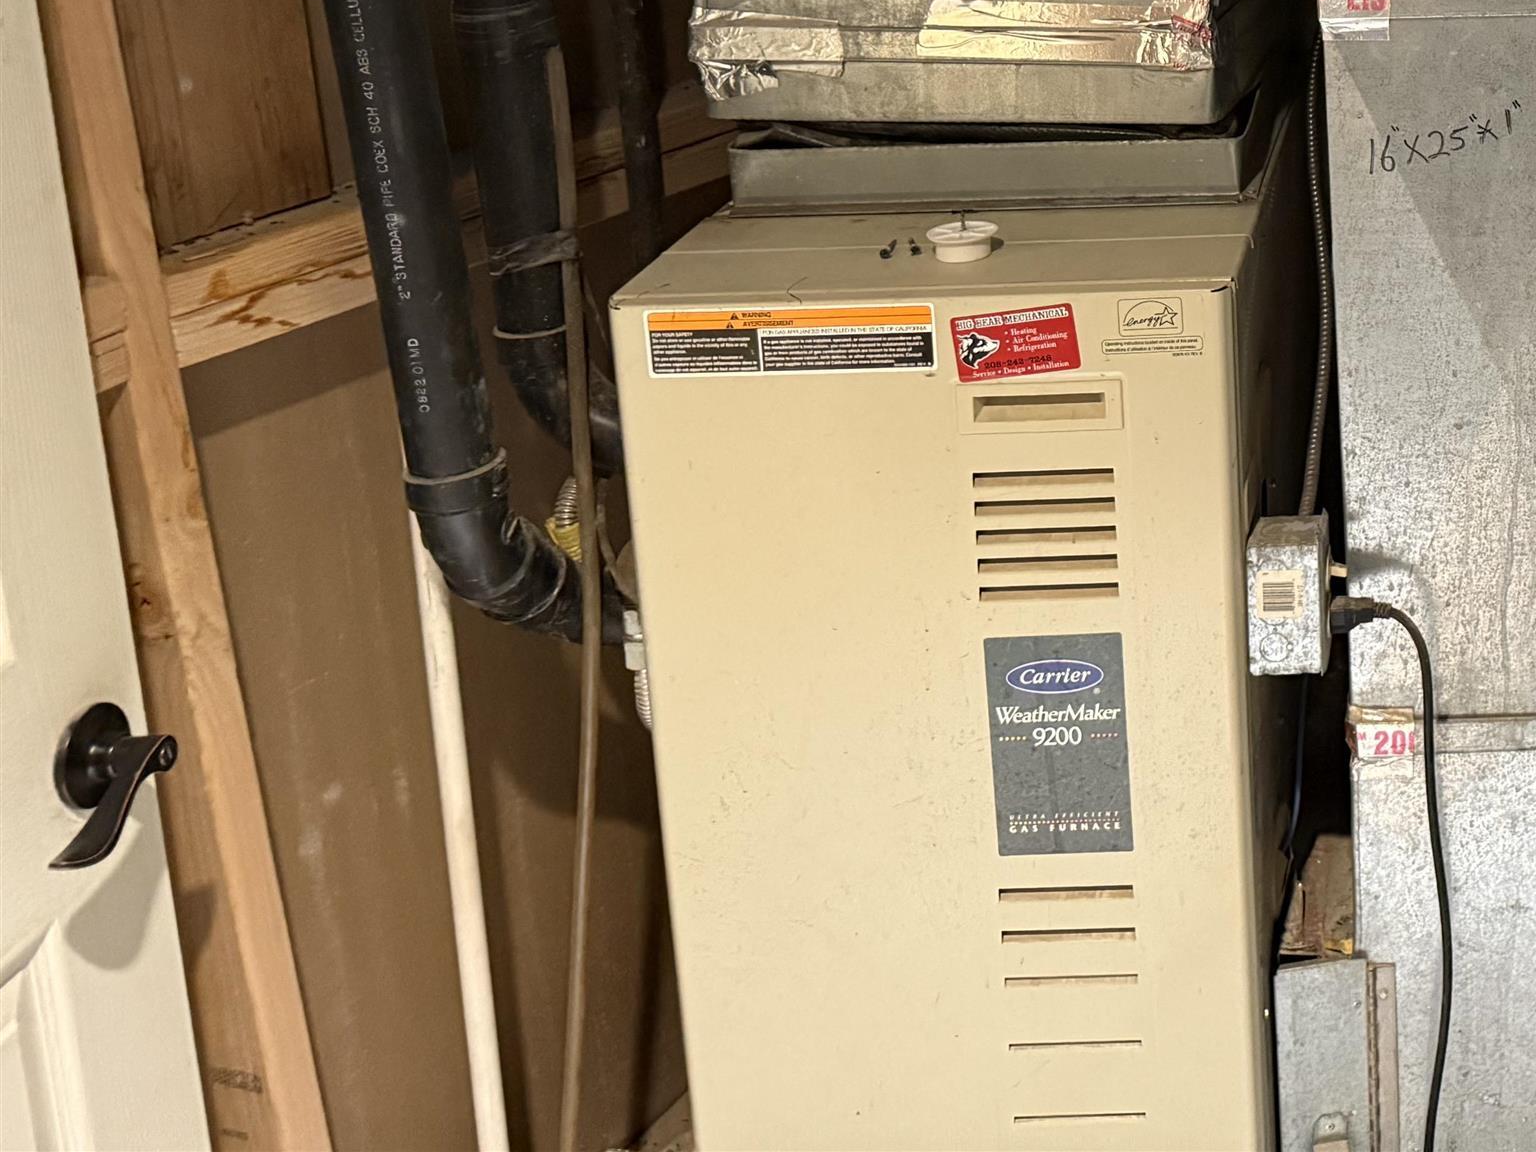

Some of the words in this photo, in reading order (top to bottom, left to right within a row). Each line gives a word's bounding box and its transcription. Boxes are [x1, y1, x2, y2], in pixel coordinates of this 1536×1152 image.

[363, 81, 375, 101] 40
[366, 106, 382, 135] SCH
[373, 140, 390, 174] COEX
[386, 213, 408, 281] STANDARD
[956, 320, 973, 330] BIG
[975, 317, 1002, 328] BEAR
[1004, 308, 1068, 324] MECHANICAL
[1125, 315, 1161, 327] energy
[1011, 328, 1037, 336] Heating
[1012, 336, 1024, 344] Air
[1026, 331, 1068, 342] Conditioning
[1004, 367, 1026, 375] Design
[1033, 361, 1070, 371] Installation
[1019, 667, 1092, 685] Carrier
[995, 703, 1121, 725] WeatherMaker
[1032, 727, 1083, 747] 9200
[1054, 810, 1120, 819] EFFICIENT
[1009, 824, 1039, 833] GAS
[1050, 821, 1121, 832] FURNACE
